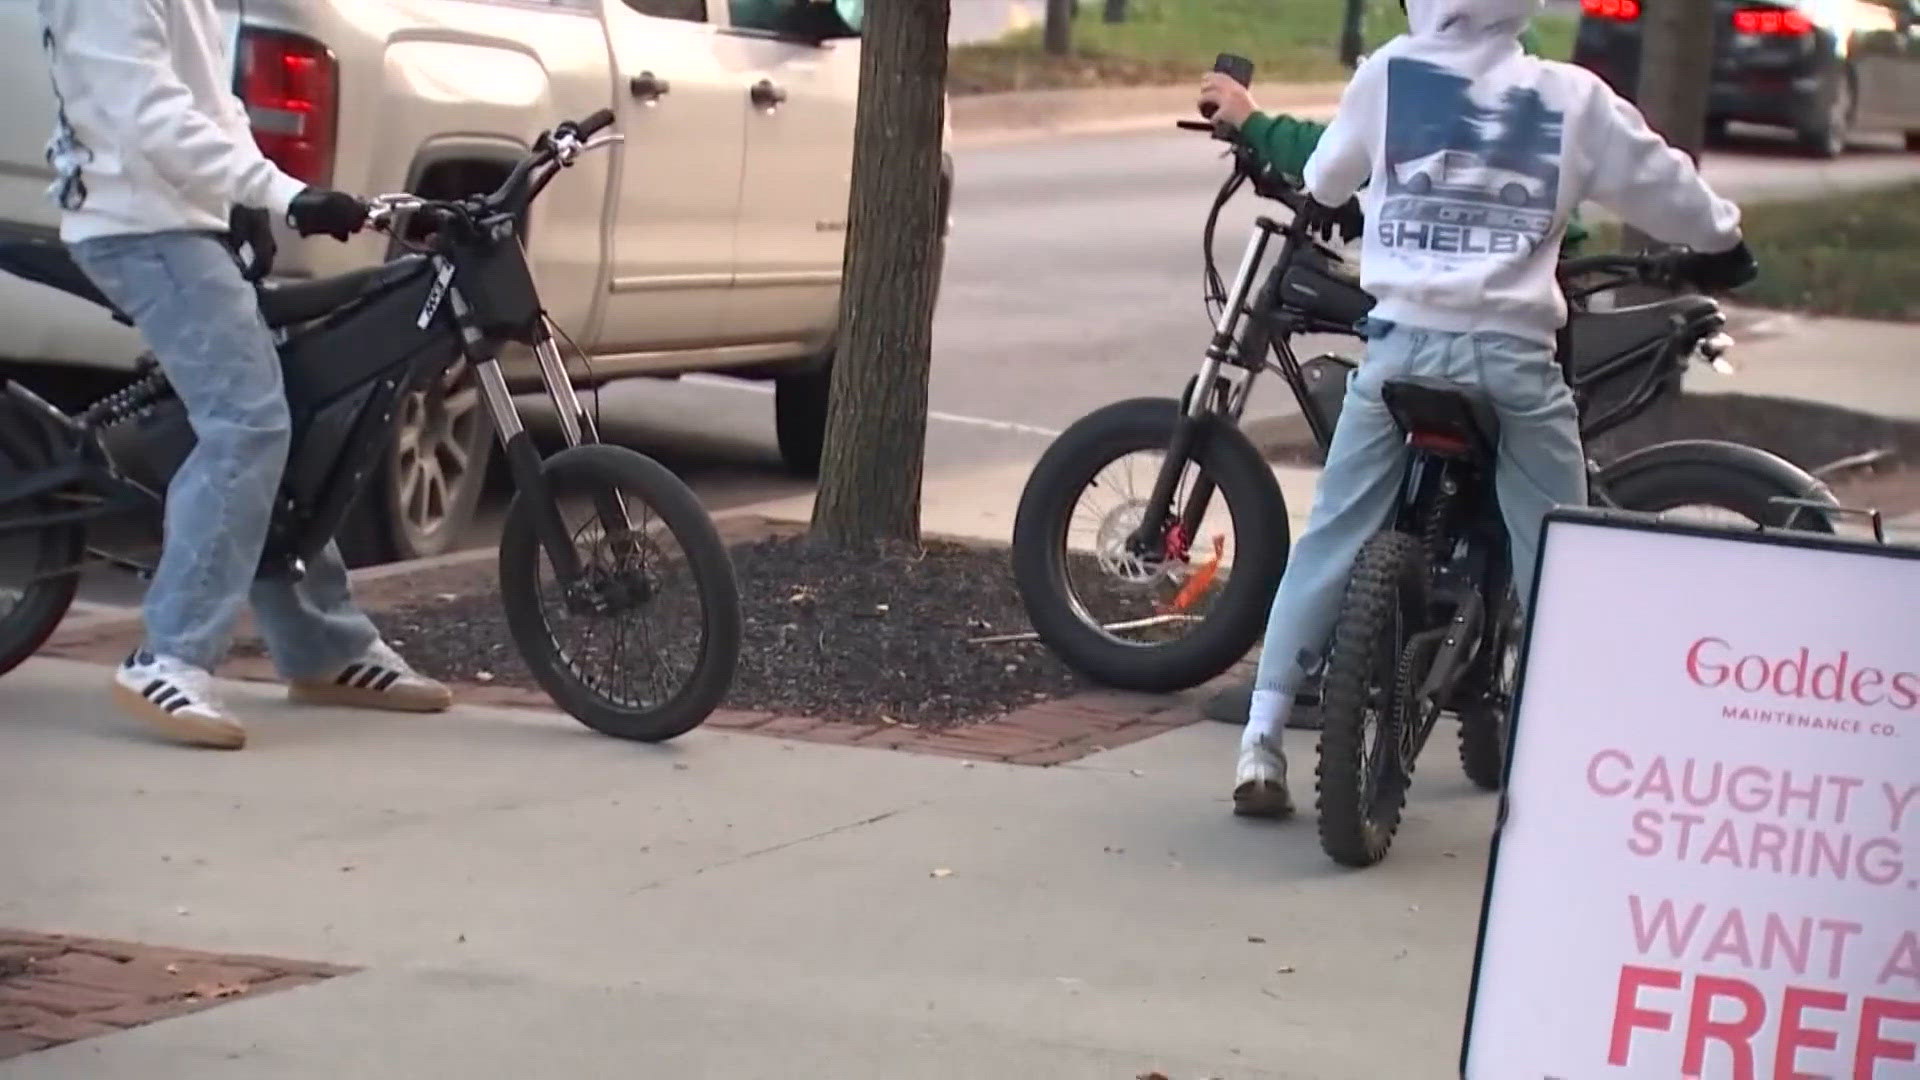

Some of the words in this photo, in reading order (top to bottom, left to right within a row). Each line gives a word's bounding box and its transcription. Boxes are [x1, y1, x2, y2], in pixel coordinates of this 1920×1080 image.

[1686, 636, 1920, 710] Goddes
[1722, 705, 1862, 734] MAINTENANCE
[1587, 749, 1864, 824] CAUGHT
[1626, 808, 1918, 891] STARING.
[1628, 894, 1863, 980] WANT
[1876, 930, 1920, 986] A
[1607, 963, 1920, 1080] FREE
